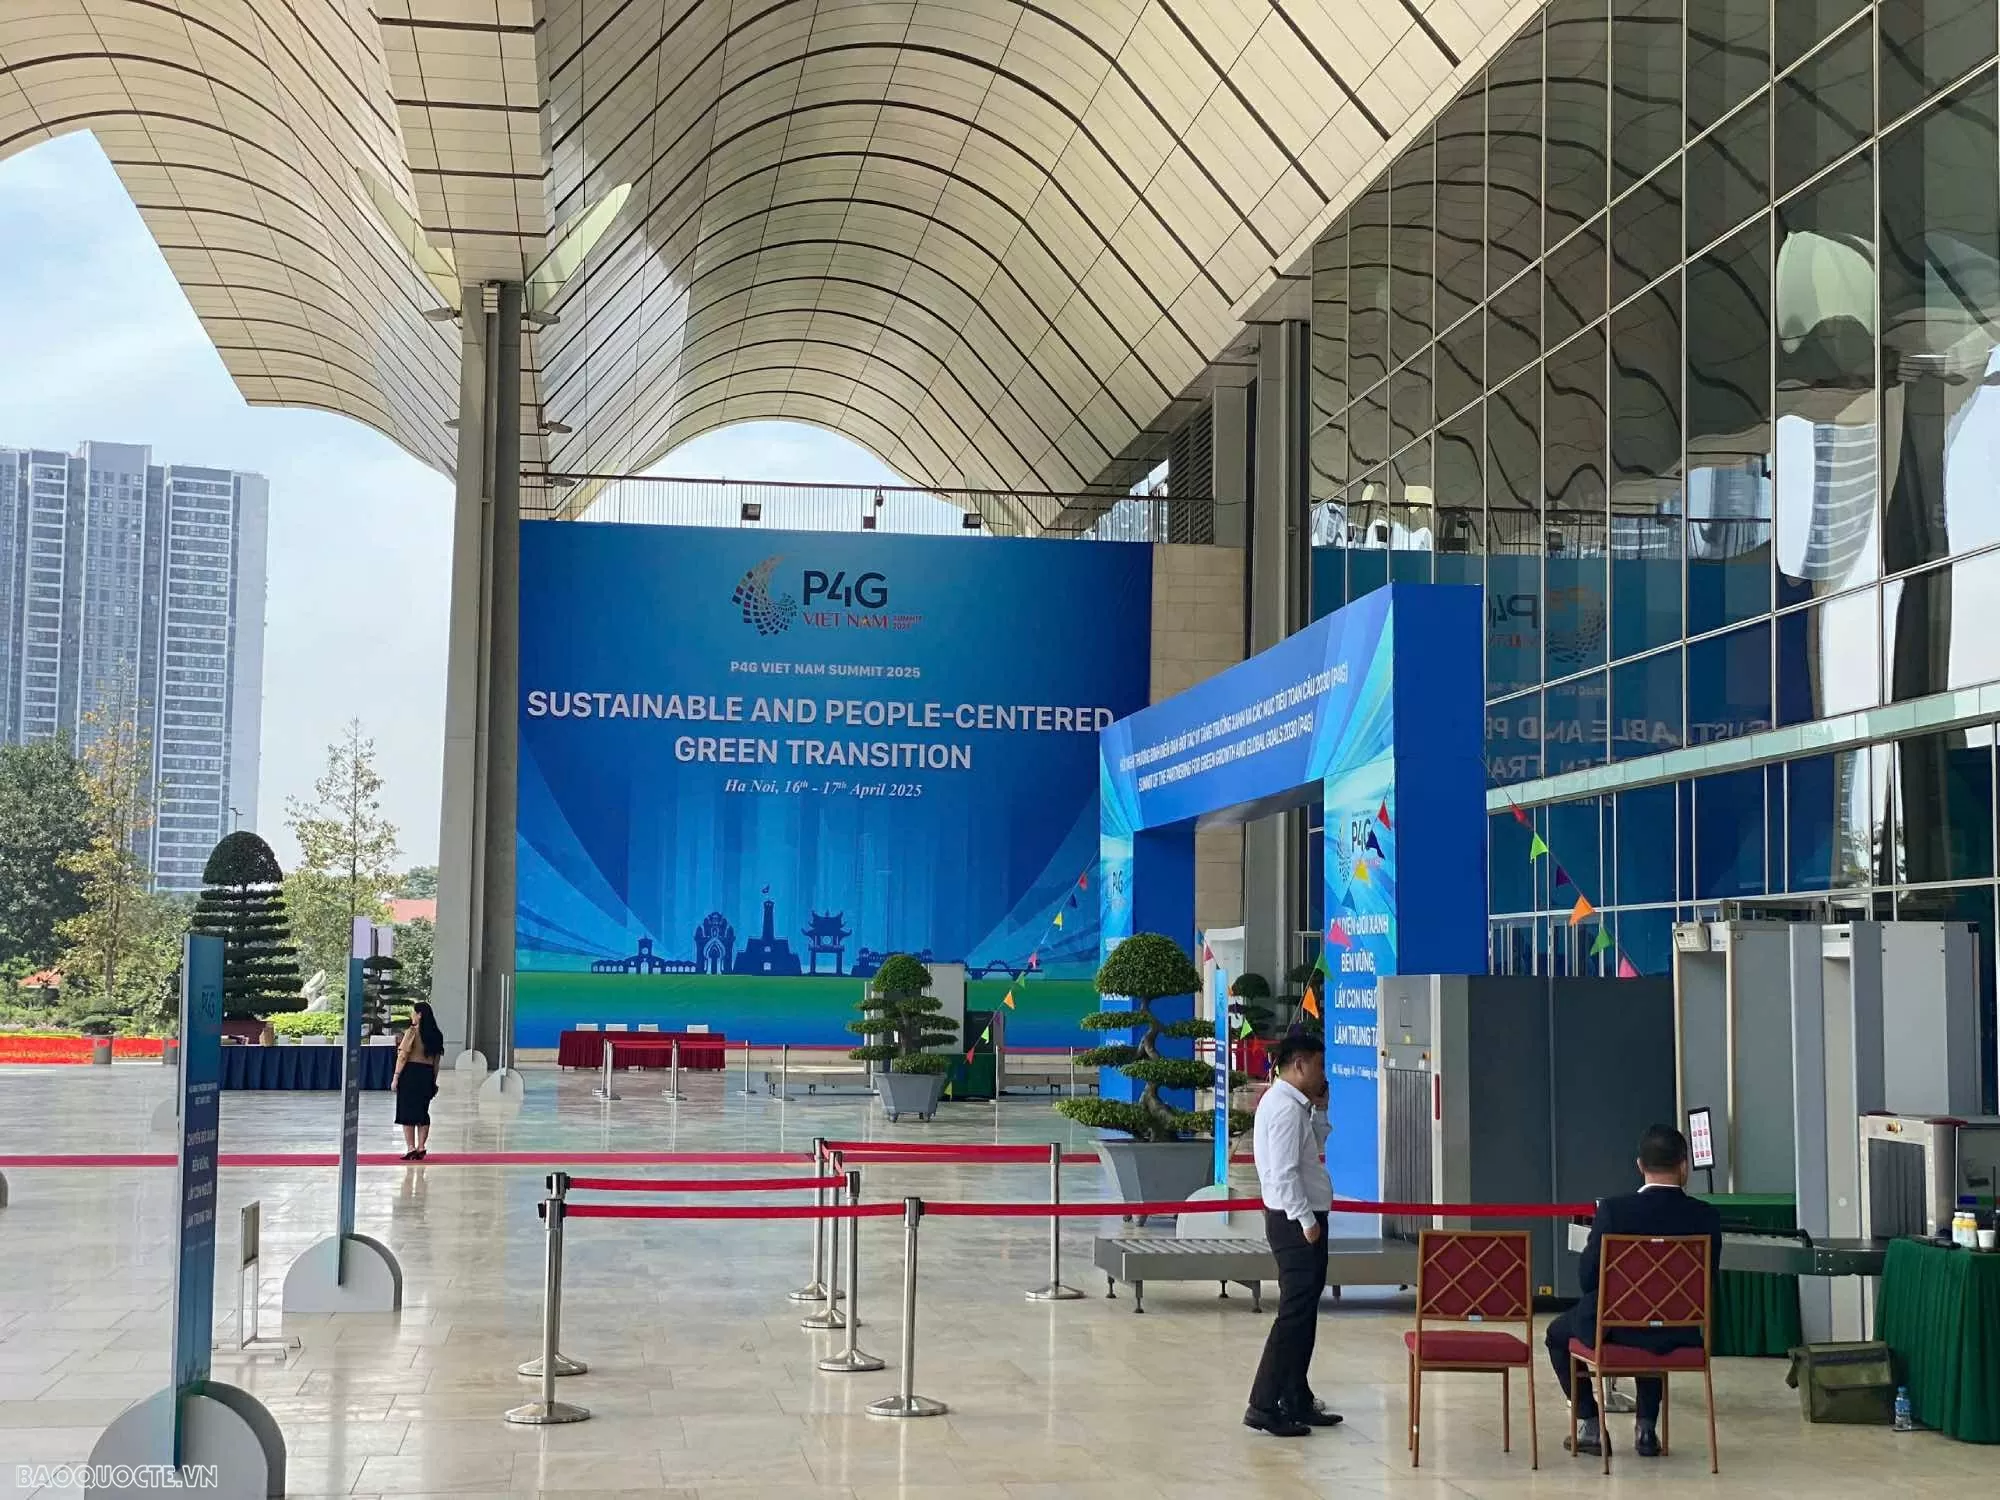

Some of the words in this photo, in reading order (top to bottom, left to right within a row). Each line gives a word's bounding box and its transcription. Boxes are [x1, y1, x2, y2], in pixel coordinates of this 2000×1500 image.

[803, 570, 888, 608] P4G
[803, 612, 841, 629] VIET
[847, 613, 888, 630] NAM
[730, 661, 758, 673] P4G
[761, 662, 791, 674] VIET
[795, 664, 825, 675] NAM
[828, 664, 884, 677] SUMMIT
[886, 666, 921, 678] 2025
[527, 690, 743, 721] SUSTAINABLE
[750, 697, 817, 724] AND
[825, 699, 1114, 733] PEOPLE-CENTERED
[674, 736, 778, 765] GREEN
[786, 739, 972, 769] TRANSITION
[725, 779, 746, 793] Ha
[749, 780, 779, 795] Noi,
[850, 783, 886, 799] April
[888, 783, 922, 797] 2025
[1347, 988, 1360, 1009] CON
[1348, 1025, 1371, 1047] TRUNG
